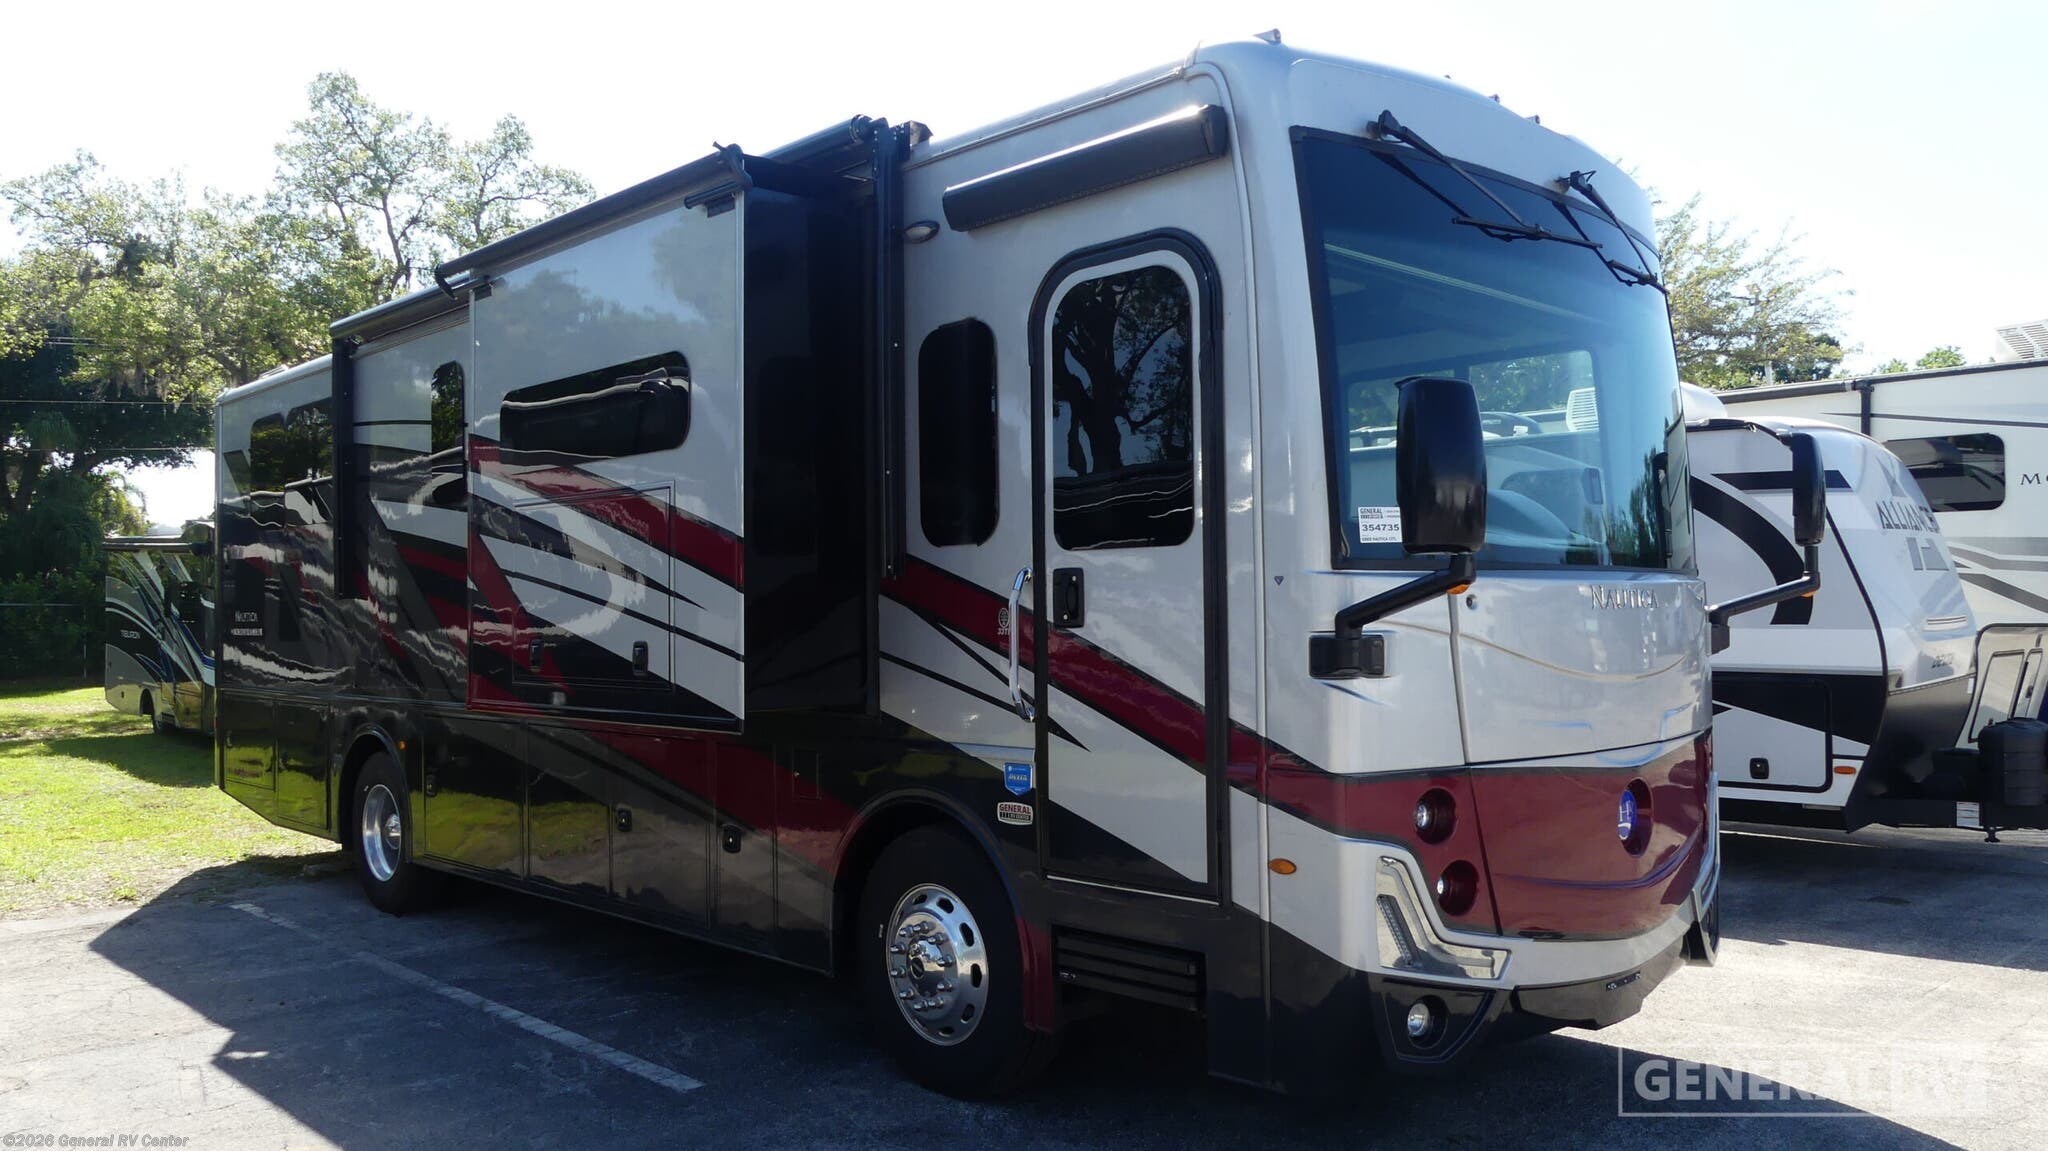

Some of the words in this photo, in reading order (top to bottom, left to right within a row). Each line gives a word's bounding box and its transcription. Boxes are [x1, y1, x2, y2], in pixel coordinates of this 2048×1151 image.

[2020, 473, 2048, 485] M
[1362, 524, 1400, 532] 354735
[1591, 585, 1658, 609] NAUTICA
[999, 803, 1031, 815] GENERAL
